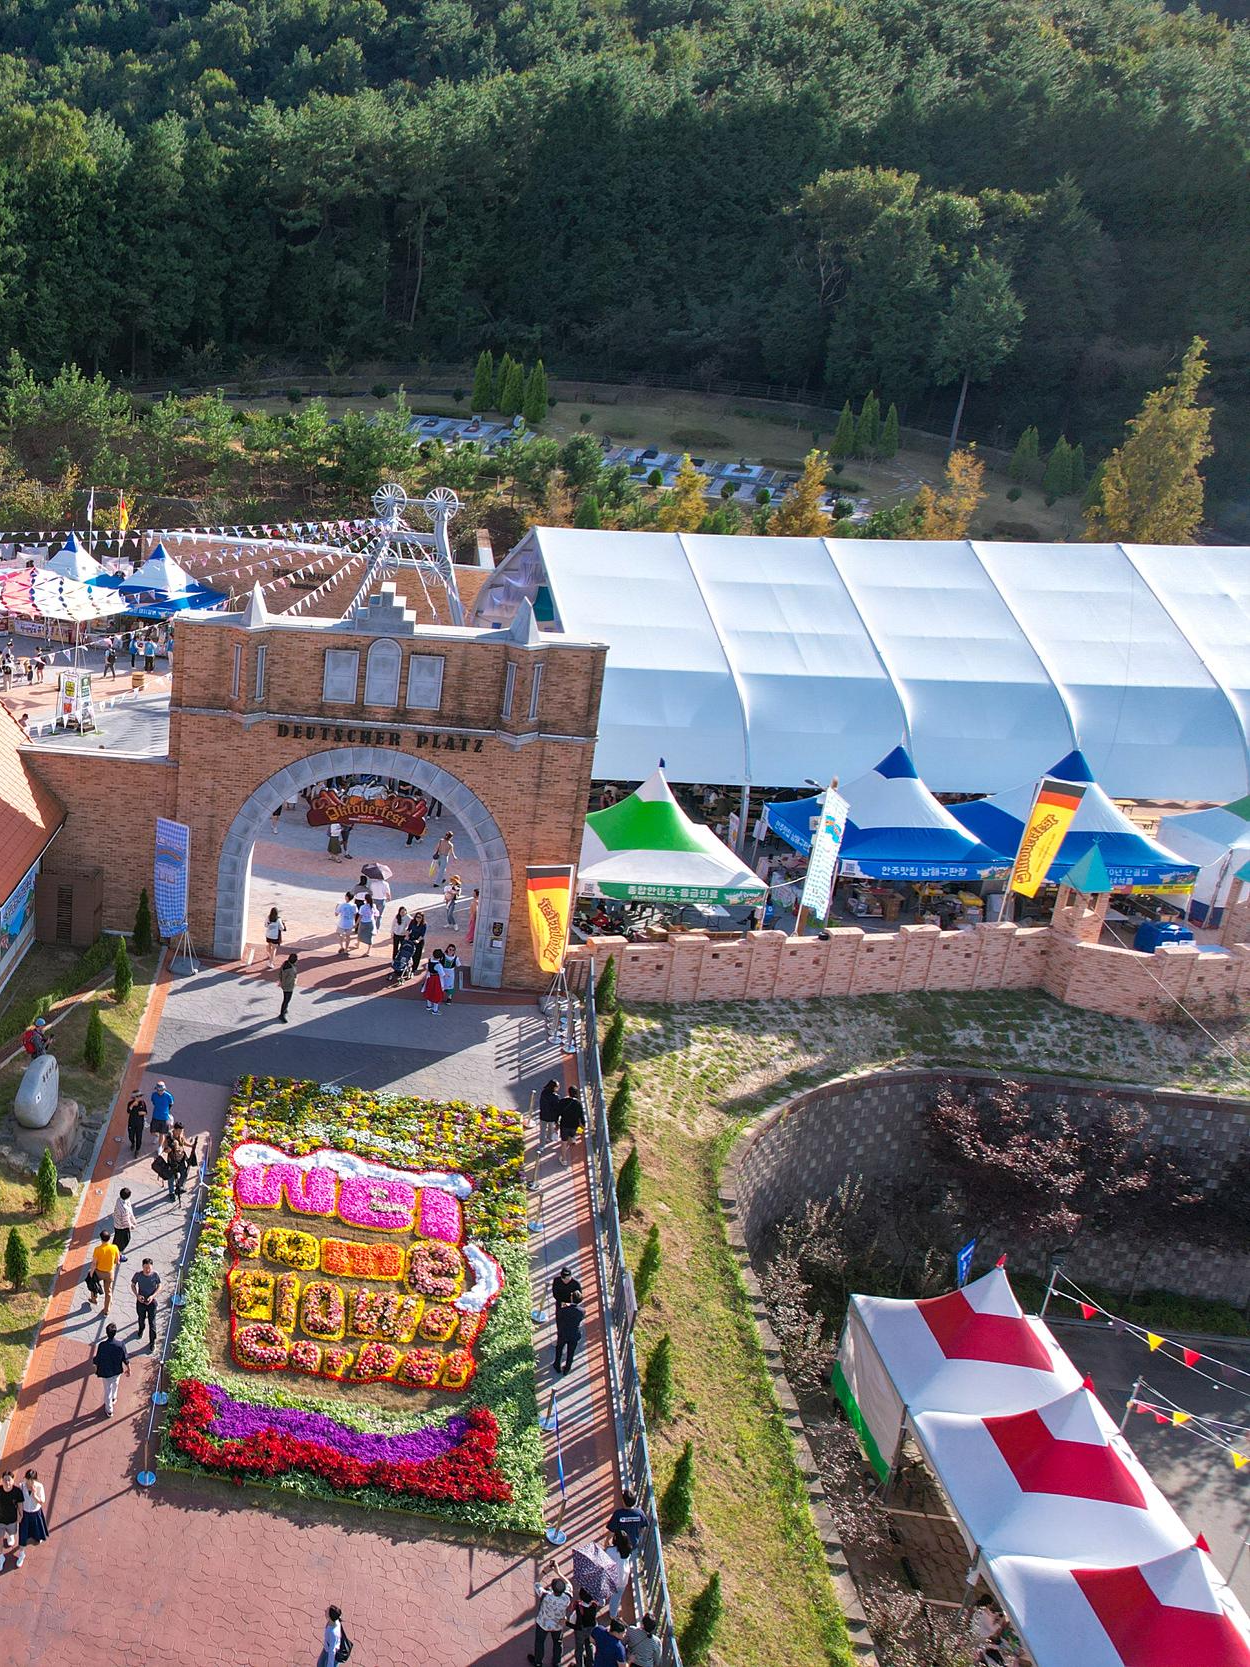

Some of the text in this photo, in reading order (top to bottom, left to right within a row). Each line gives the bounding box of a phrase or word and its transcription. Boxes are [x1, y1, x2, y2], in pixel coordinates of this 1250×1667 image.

[277, 723, 485, 753] DEUTSCHER PLATZ
[325, 800, 407, 827] Oktoberfest
[1014, 813, 1060, 884] Oktoberfest
[881, 865, 969, 878] 안주맛집 남해구판장
